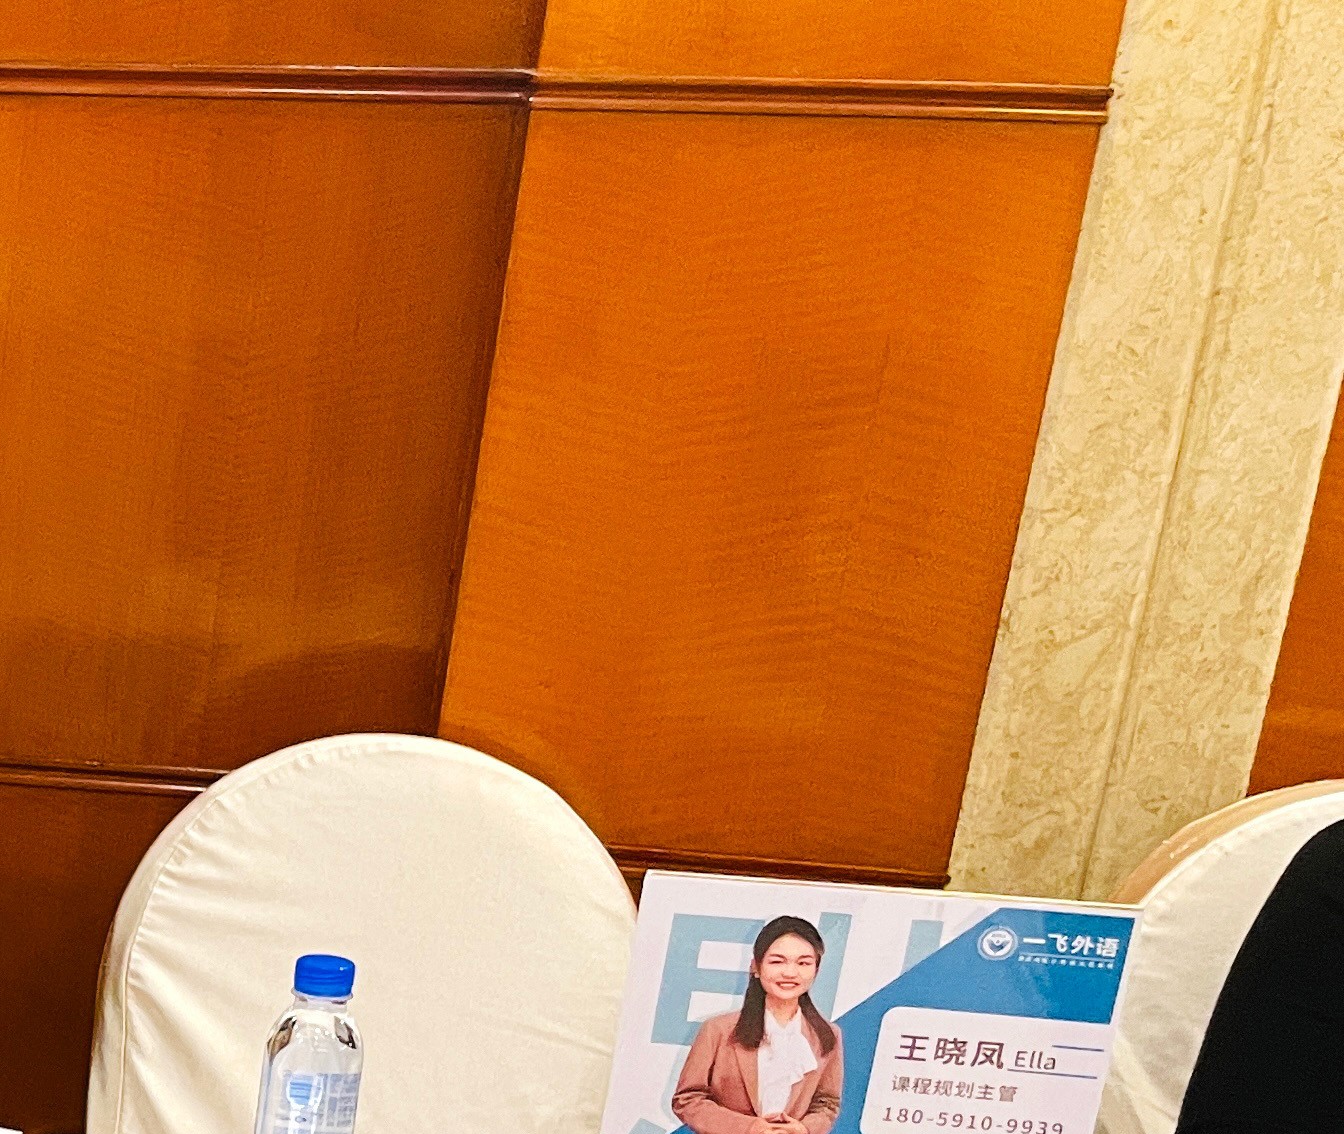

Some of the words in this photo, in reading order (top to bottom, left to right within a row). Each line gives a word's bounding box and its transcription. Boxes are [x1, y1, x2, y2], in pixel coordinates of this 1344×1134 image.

[1021, 932, 1120, 959] 一飞外语
[894, 1032, 1005, 1071] 王晓凤
[1013, 1049, 1058, 1073] Ella
[891, 1074, 1019, 1104] 课程规划主管
